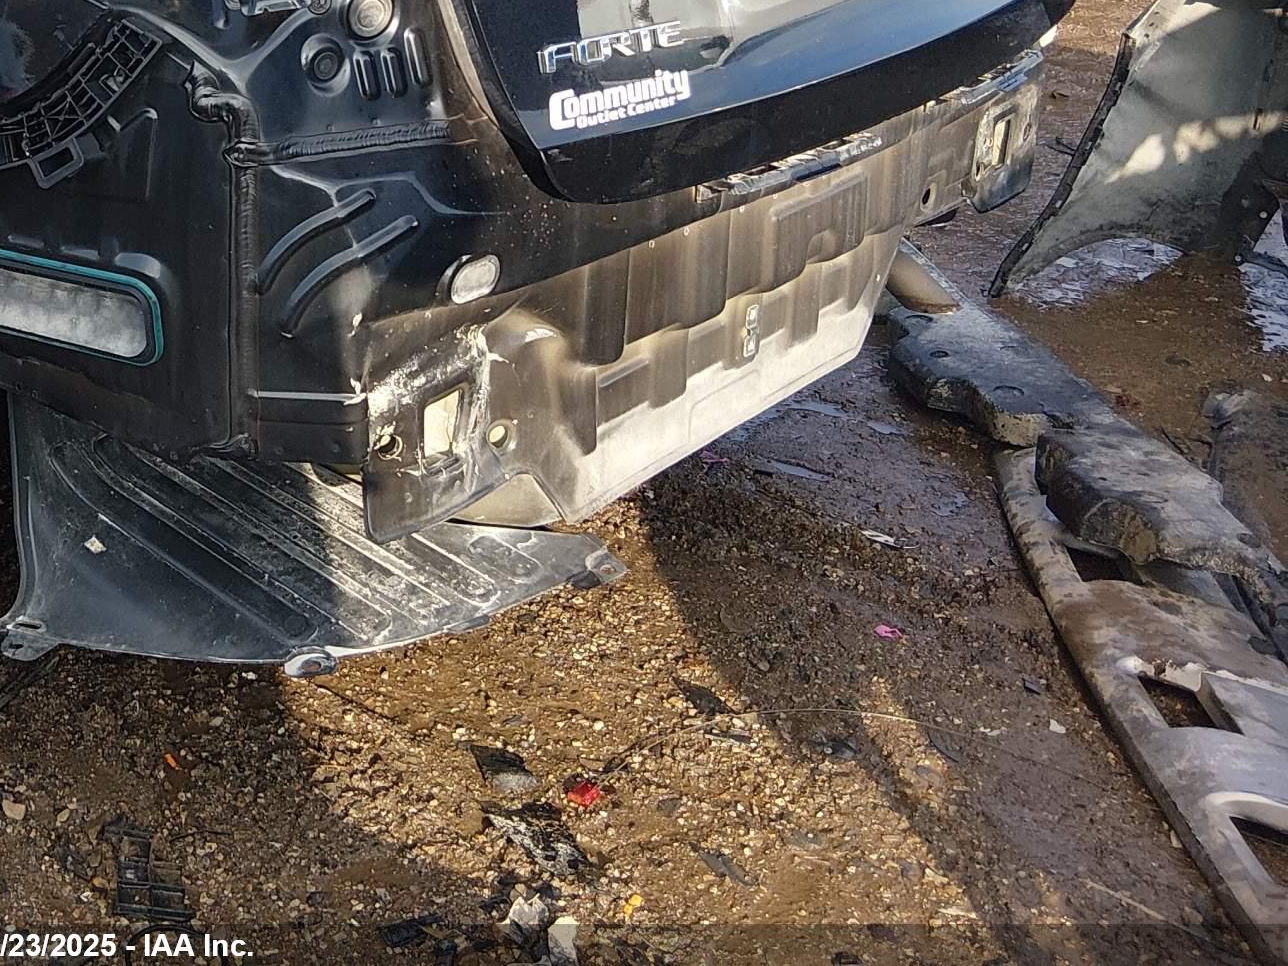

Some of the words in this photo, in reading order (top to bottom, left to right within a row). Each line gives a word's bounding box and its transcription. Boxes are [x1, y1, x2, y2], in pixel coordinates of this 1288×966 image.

[537, 20, 686, 75] FORTE
[549, 69, 691, 131] Community
[576, 106, 628, 129] Outlet
[626, 95, 678, 118] Center
